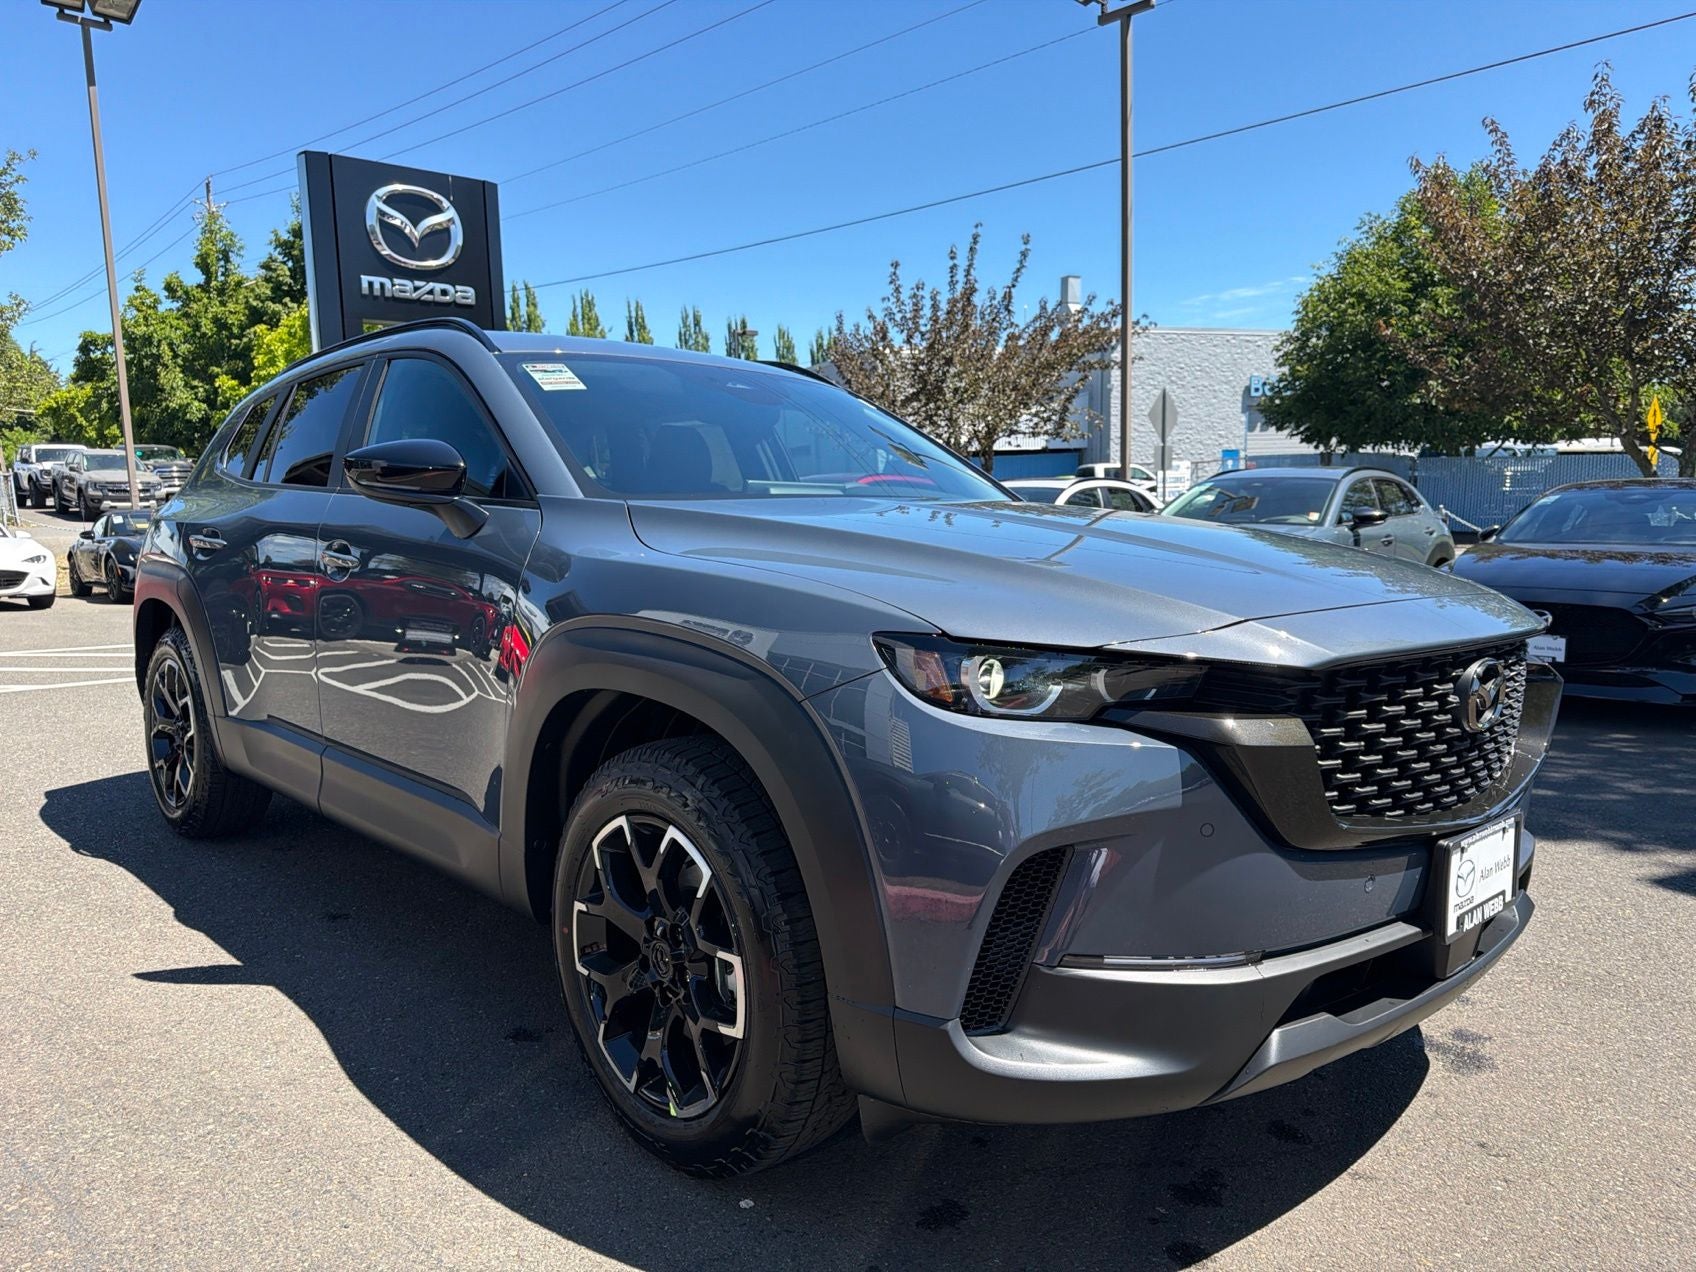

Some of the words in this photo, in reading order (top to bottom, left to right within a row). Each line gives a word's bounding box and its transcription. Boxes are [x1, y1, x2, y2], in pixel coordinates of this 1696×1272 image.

[1479, 864, 1494, 883] Alan
[1494, 854, 1511, 875] Webb
[1463, 904, 1484, 932] ALAN
[1483, 894, 1504, 921] WEBB
